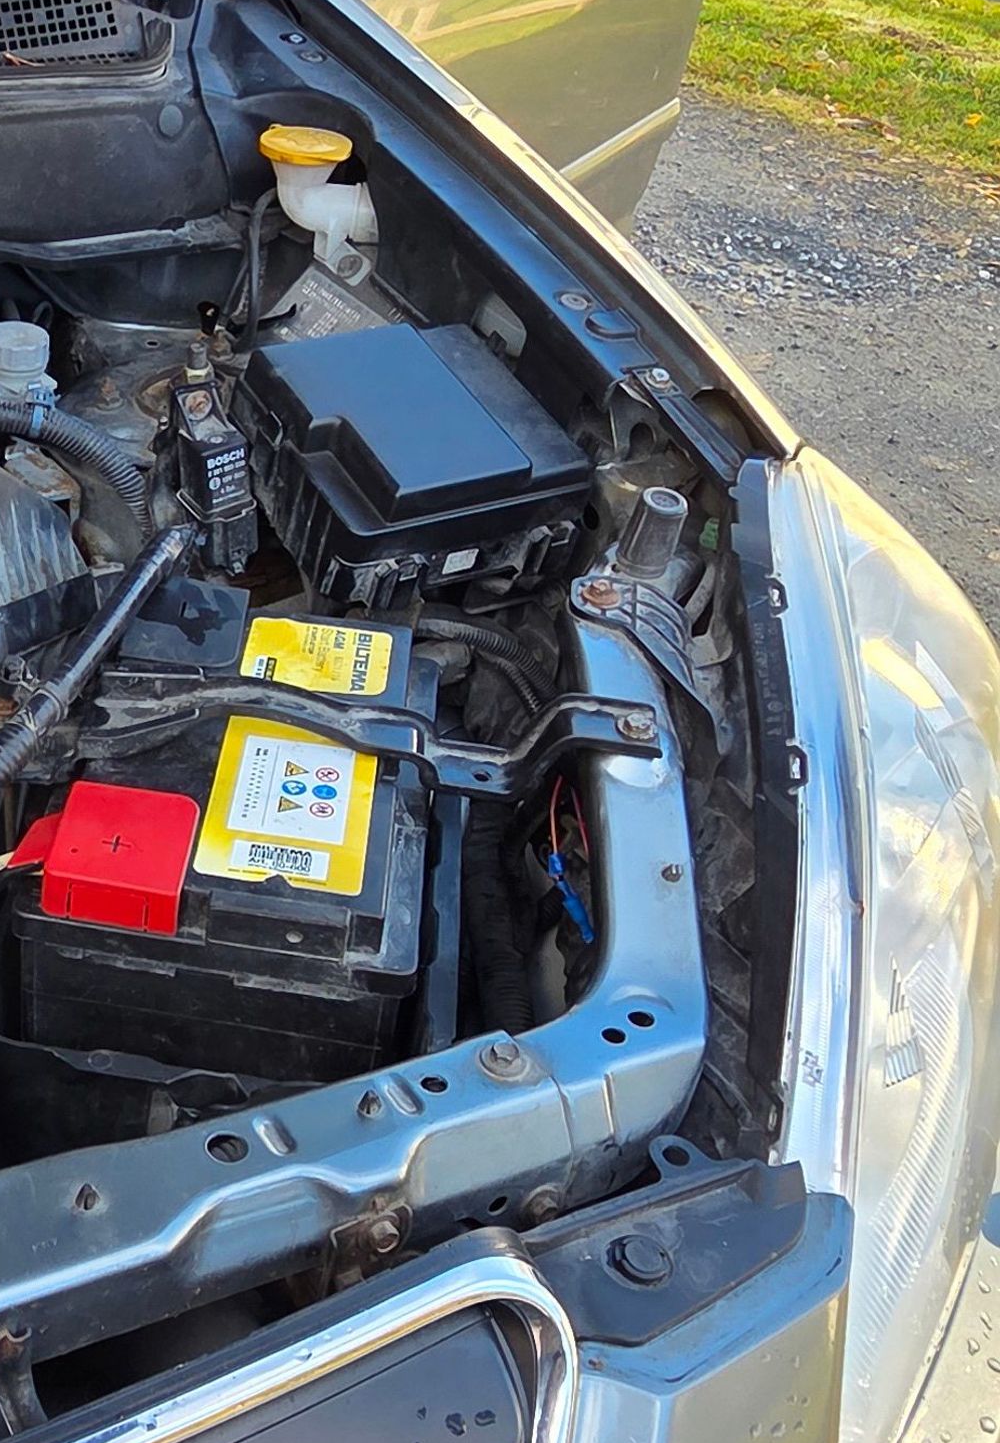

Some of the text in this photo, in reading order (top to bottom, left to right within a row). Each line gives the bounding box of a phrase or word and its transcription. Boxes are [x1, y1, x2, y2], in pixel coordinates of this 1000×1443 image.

[206, 448, 245, 469] BOSCH
[333, 630, 346, 650] AGM
[350, 633, 372, 691] BILTEMA
